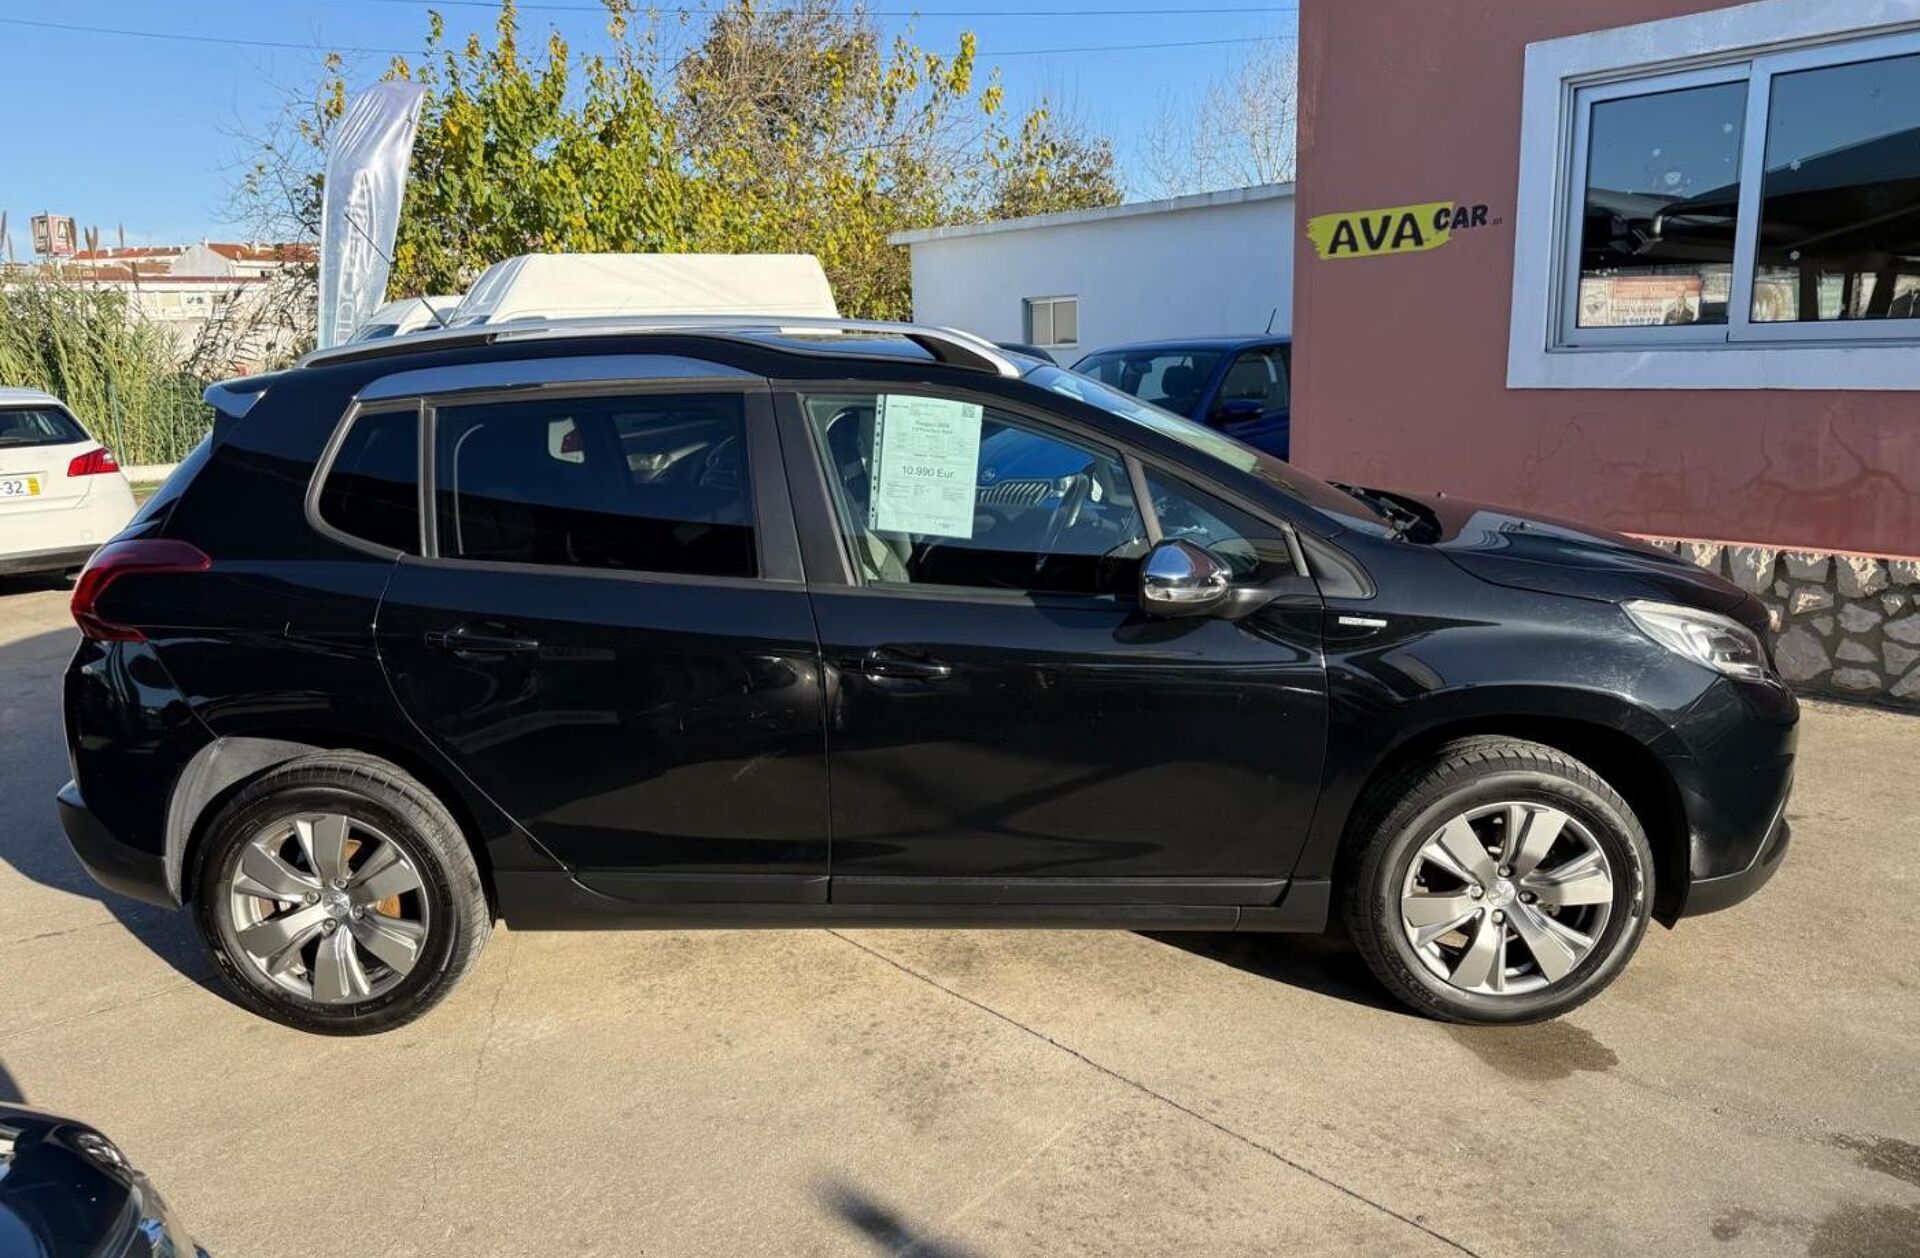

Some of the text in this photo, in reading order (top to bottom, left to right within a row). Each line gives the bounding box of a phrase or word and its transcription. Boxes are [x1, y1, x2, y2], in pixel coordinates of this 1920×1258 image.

[1328, 213, 1424, 254] AVA
[1433, 204, 1488, 231] CAR
[903, 465, 935, 477] 10.990
